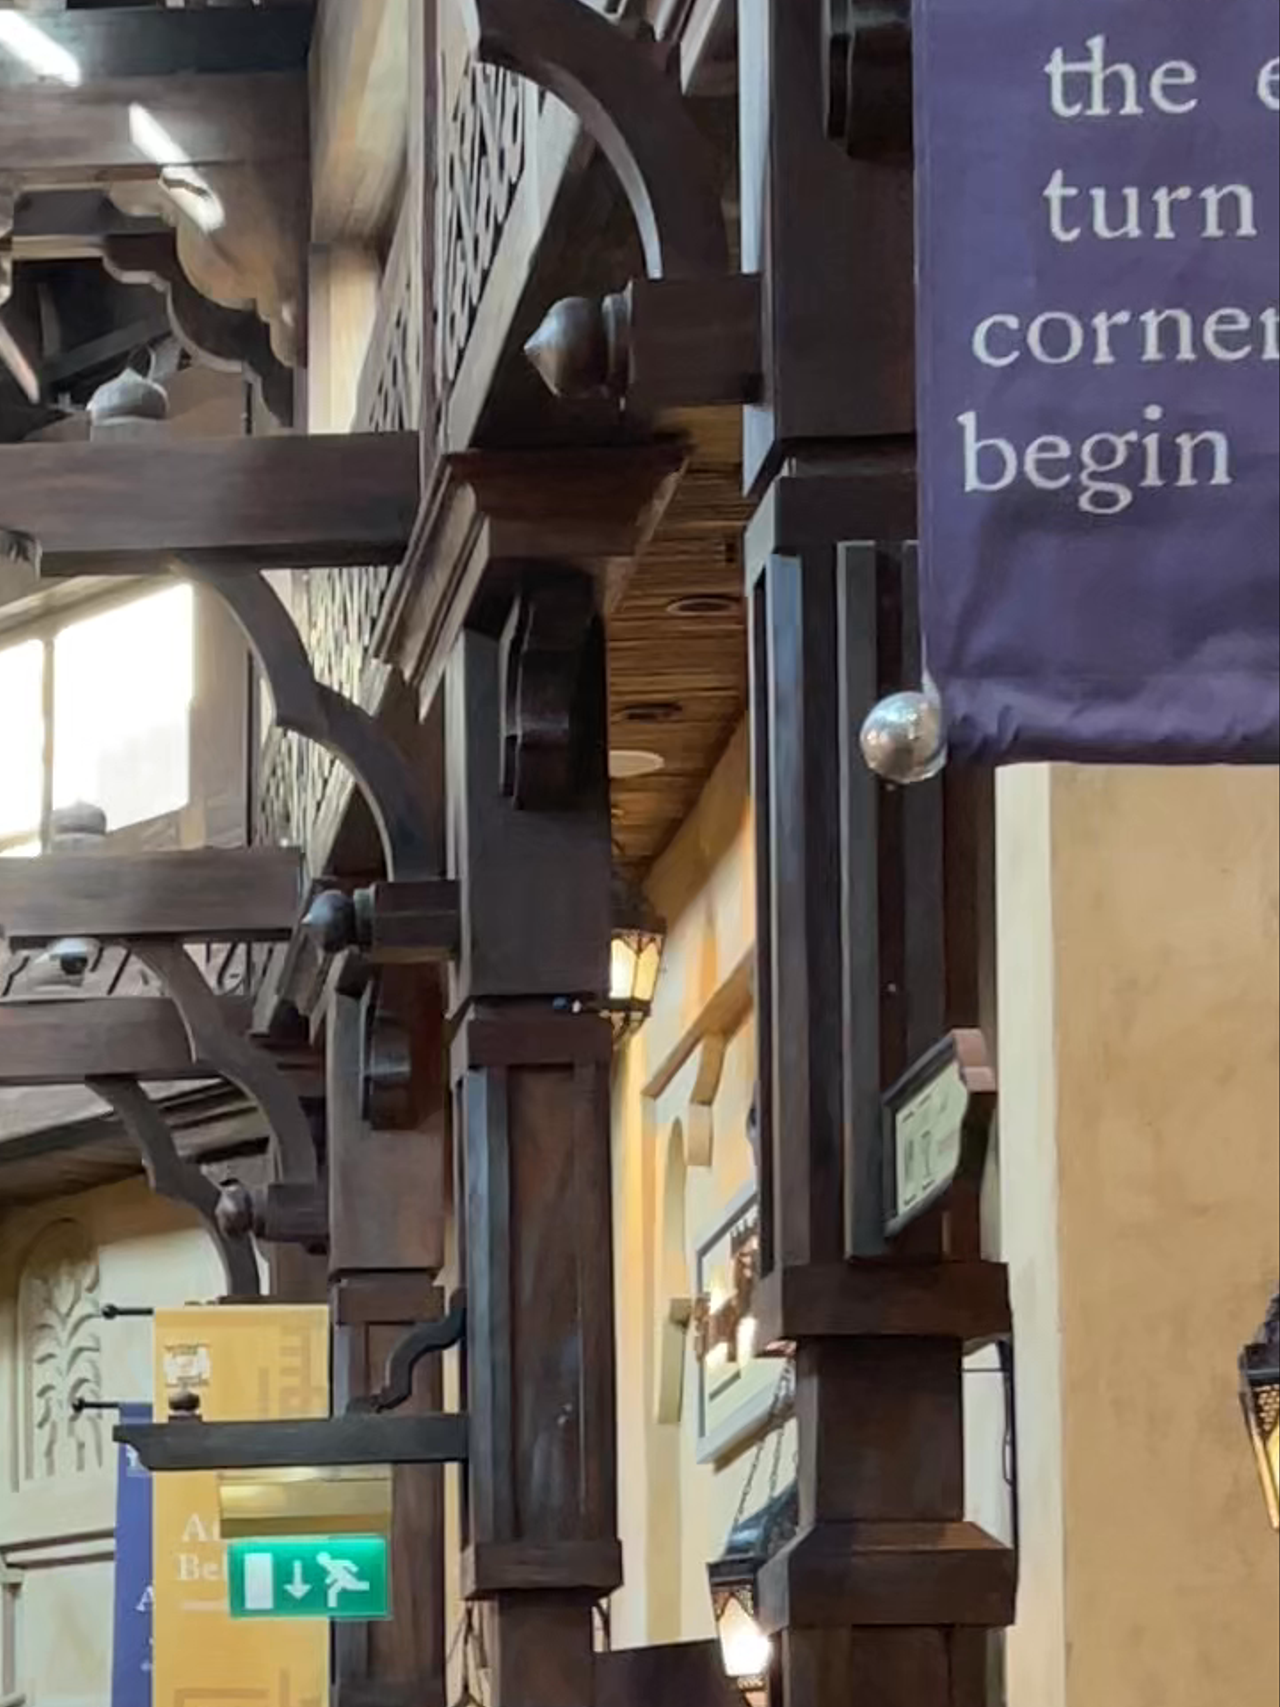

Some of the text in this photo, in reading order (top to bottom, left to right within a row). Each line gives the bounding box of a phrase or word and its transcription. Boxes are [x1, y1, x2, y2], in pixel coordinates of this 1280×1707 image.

[1043, 33, 1198, 119] the
[1042, 166, 1259, 243] turn
[956, 403, 1234, 515] begin
